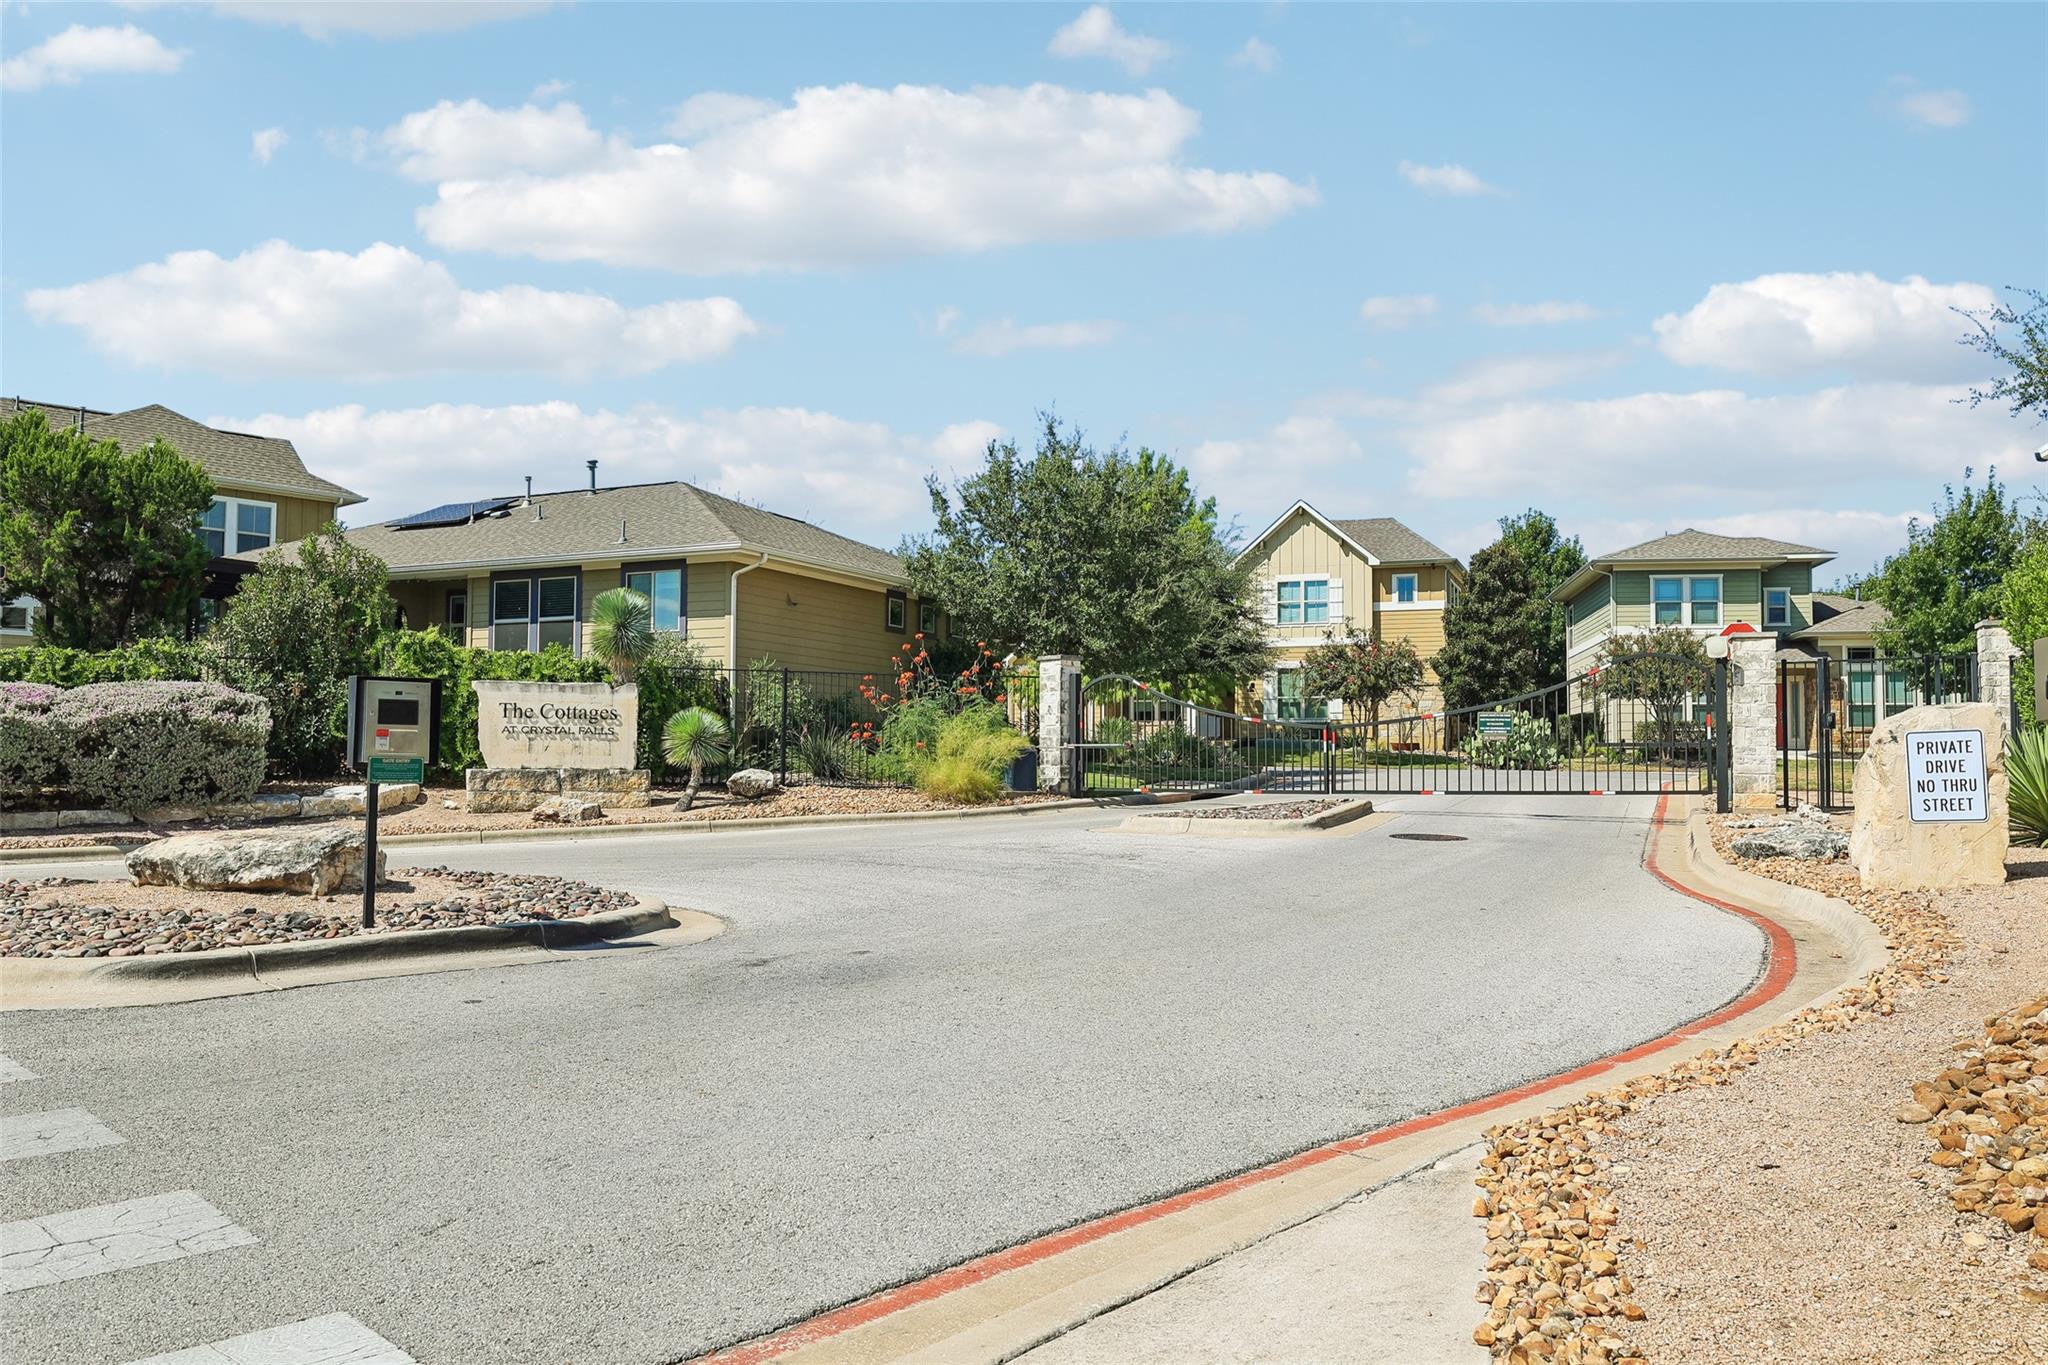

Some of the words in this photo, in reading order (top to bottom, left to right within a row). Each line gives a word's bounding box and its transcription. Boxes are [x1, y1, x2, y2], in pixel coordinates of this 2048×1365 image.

[499, 702, 534, 719] The
[540, 703, 617, 725] Cottages
[501, 725, 517, 734] AT
[521, 725, 575, 735] CRYSTAL
[578, 726, 615, 736] FALLS
[1916, 740, 1973, 755] PRIVATE
[1925, 759, 1966, 774] DRIVE
[1917, 779, 1935, 793] NO
[1942, 778, 1977, 792] THRU
[1923, 797, 1973, 812] STREET
